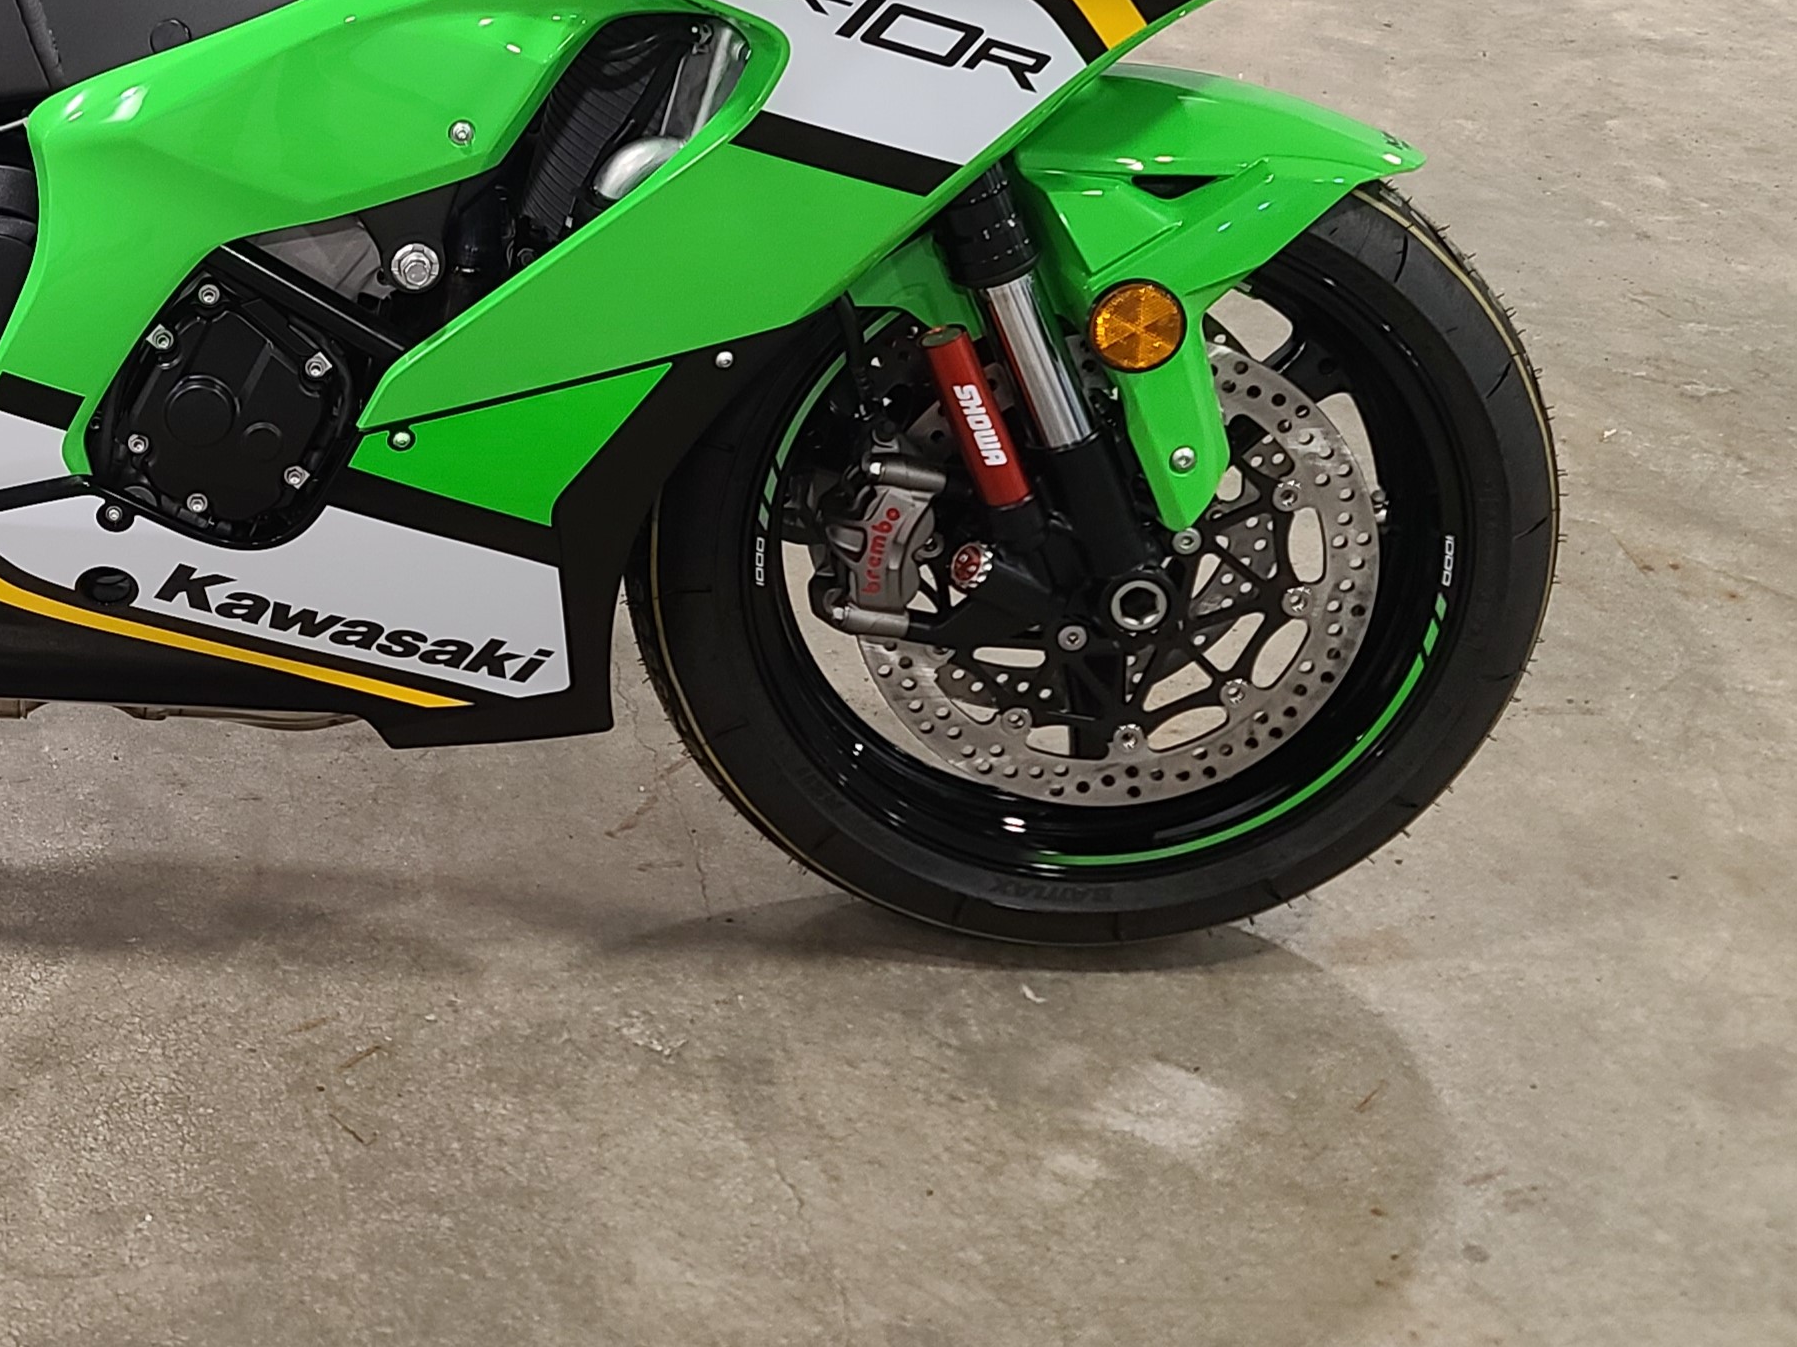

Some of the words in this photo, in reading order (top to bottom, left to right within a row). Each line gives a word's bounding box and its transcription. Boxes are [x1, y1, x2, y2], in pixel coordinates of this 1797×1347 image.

[953, 384, 1007, 467] SHOWA
[754, 537, 766, 587] 1000
[861, 508, 900, 594] brembo
[1442, 535, 1455, 586] 1000
[153, 562, 555, 684] Kawasaki
